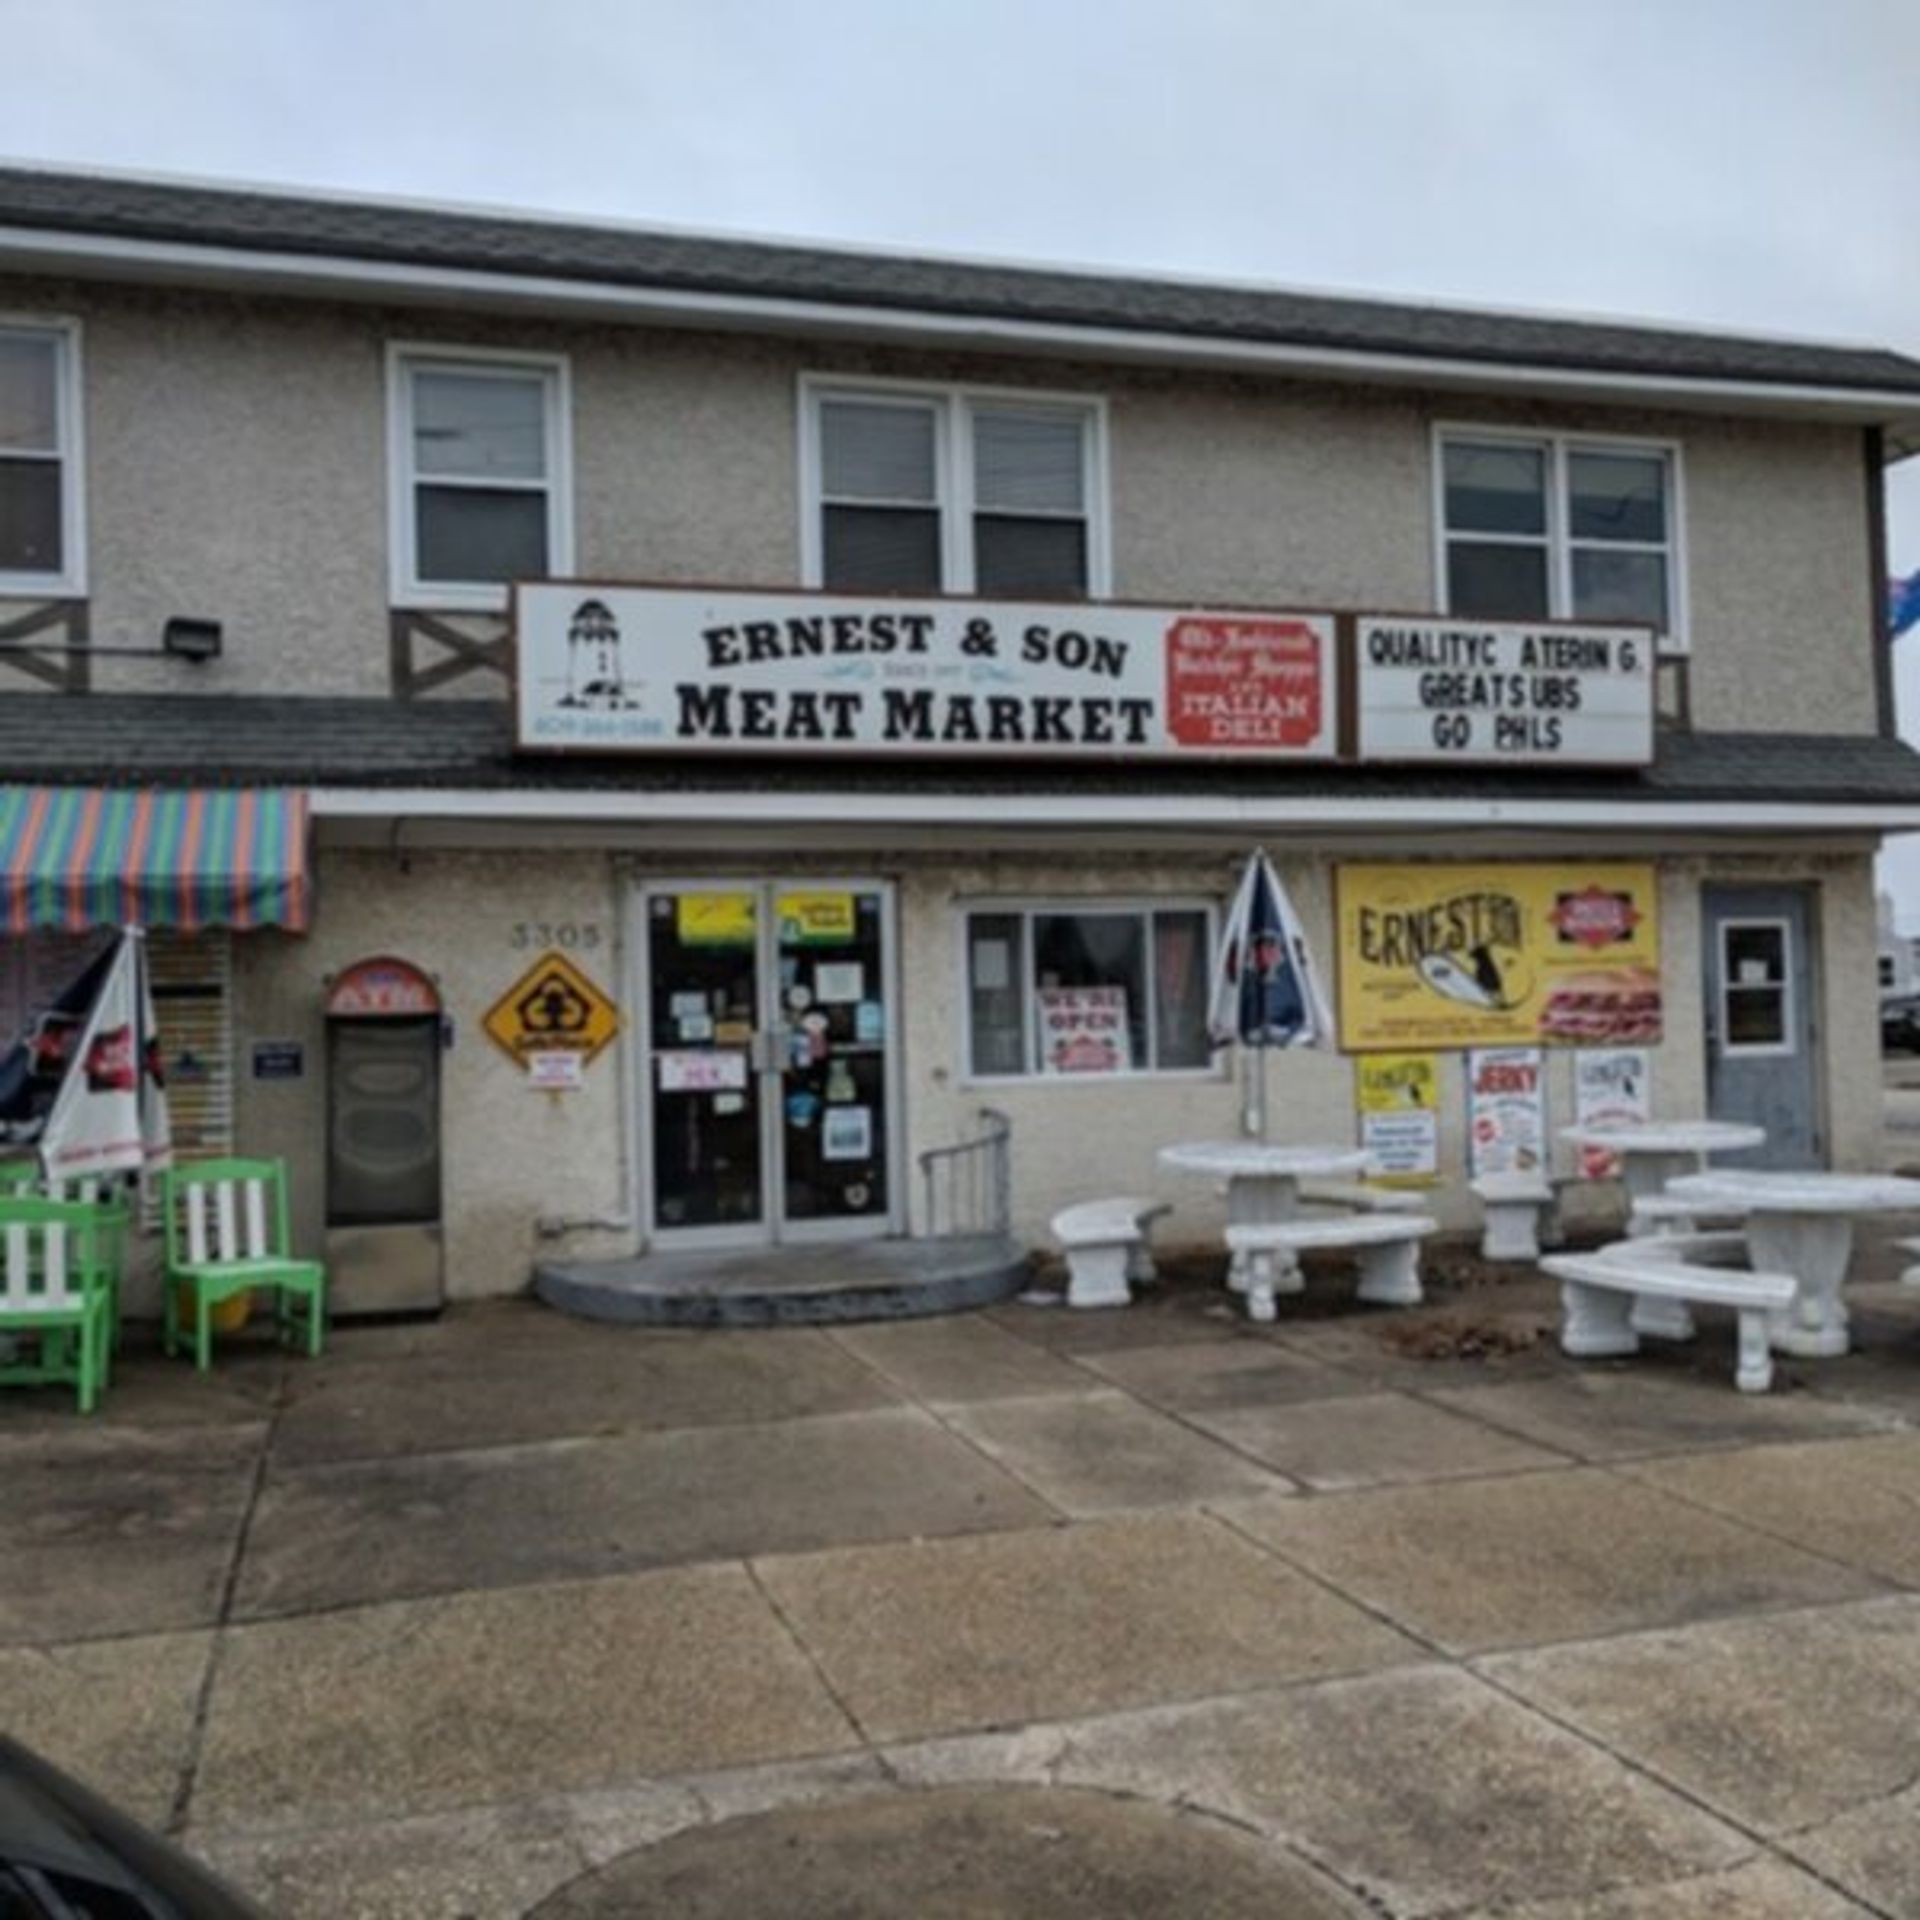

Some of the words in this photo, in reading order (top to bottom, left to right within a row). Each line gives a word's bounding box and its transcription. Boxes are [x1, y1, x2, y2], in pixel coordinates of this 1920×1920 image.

[703, 614, 934, 668] ERNEST
[960, 618, 997, 657] &
[1021, 625, 1128, 678] SON
[676, 684, 862, 741] MEAT
[882, 688, 1154, 744] MARKET
[1181, 692, 1307, 716] ITALIAN
[1210, 718, 1281, 740] DELI
[1433, 713, 1471, 750] GO
